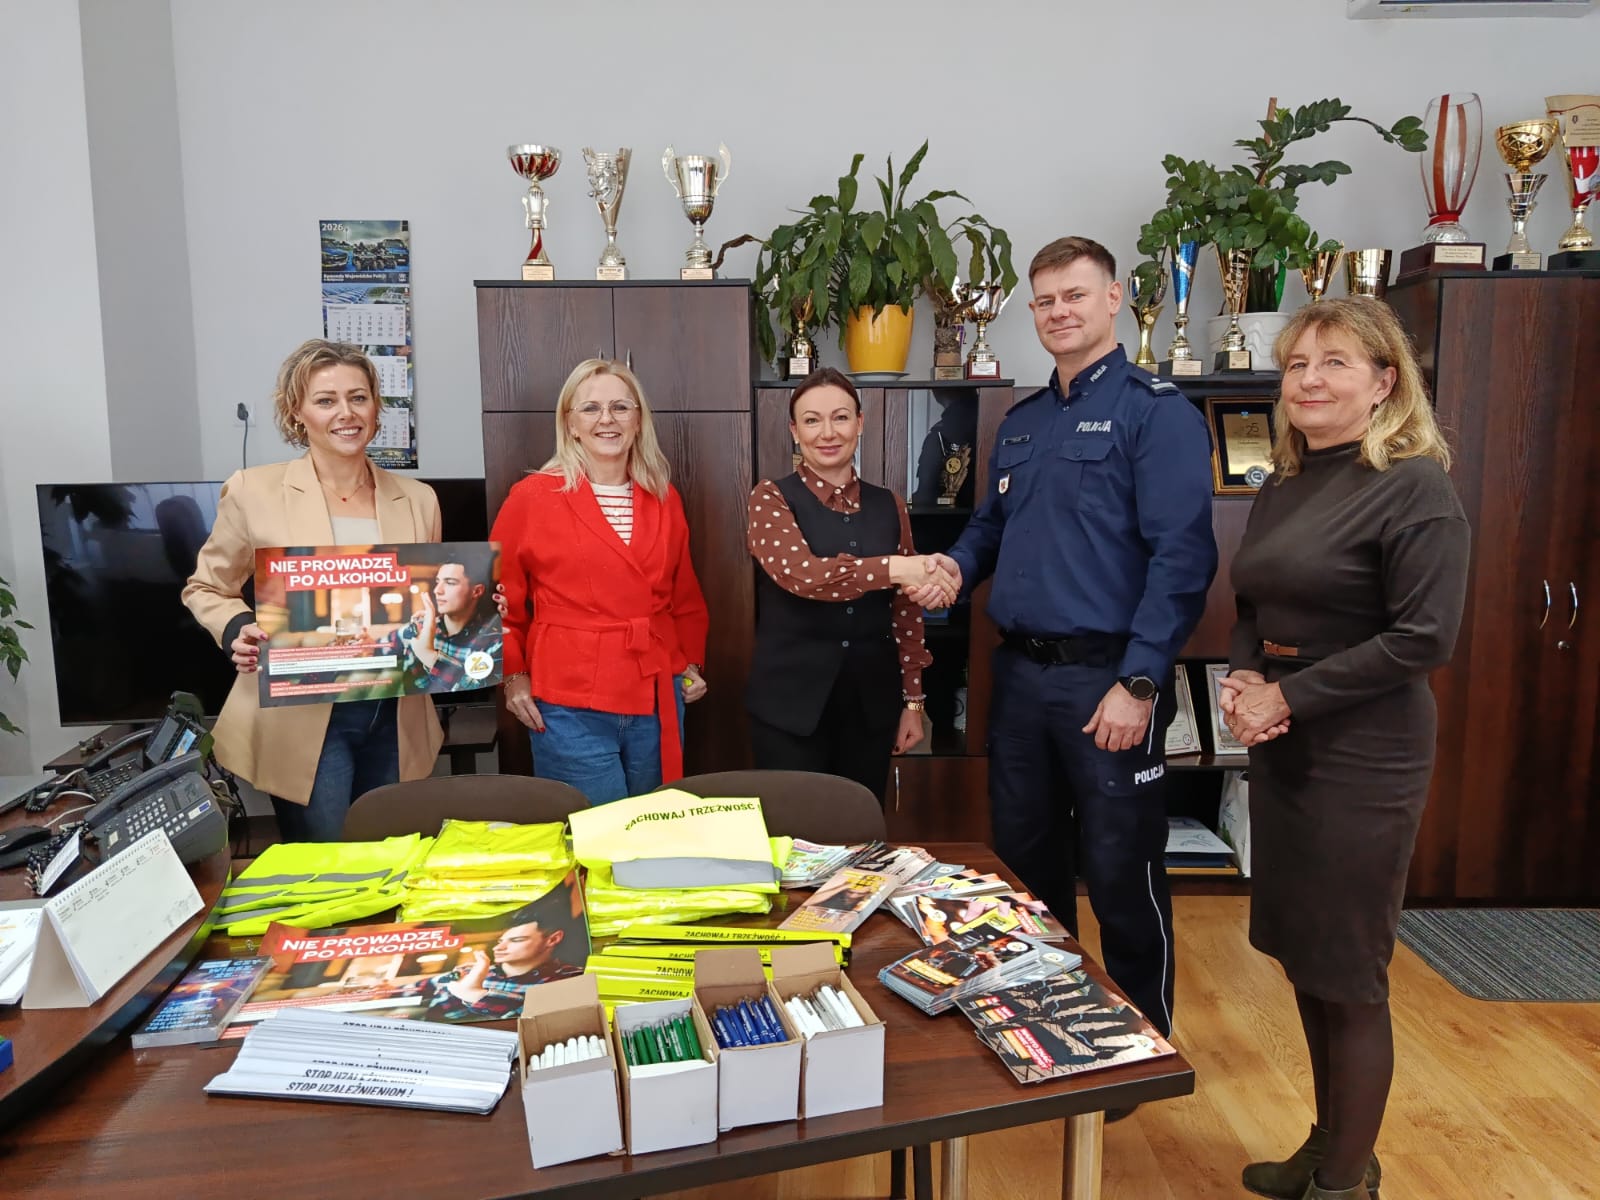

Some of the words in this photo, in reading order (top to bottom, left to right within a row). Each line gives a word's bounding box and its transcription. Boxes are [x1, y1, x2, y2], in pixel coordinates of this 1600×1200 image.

[321, 223, 343, 231] 2026
[1075, 420, 1111, 432] POLICJA
[270, 560, 297, 573] NIE
[301, 556, 393, 571] PROWADZĘ
[289, 575, 314, 587] PO
[317, 570, 407, 585] ALKOHOLU
[1134, 763, 1164, 784] POLICJA
[625, 810, 685, 831] ZACHOWAJ
[282, 939, 318, 950] NIE
[323, 930, 444, 948] PROWADZĘ
[302, 949, 335, 960] PO
[338, 938, 460, 957] ALKOHOLU
[656, 966, 695, 977] ZACHOW
[639, 988, 690, 998] ZACHOWAJ
[286, 1082, 317, 1091] STOP
[319, 1082, 406, 1096] UZALEŹNIENIOM
[406, 1088, 414, 1098] !
